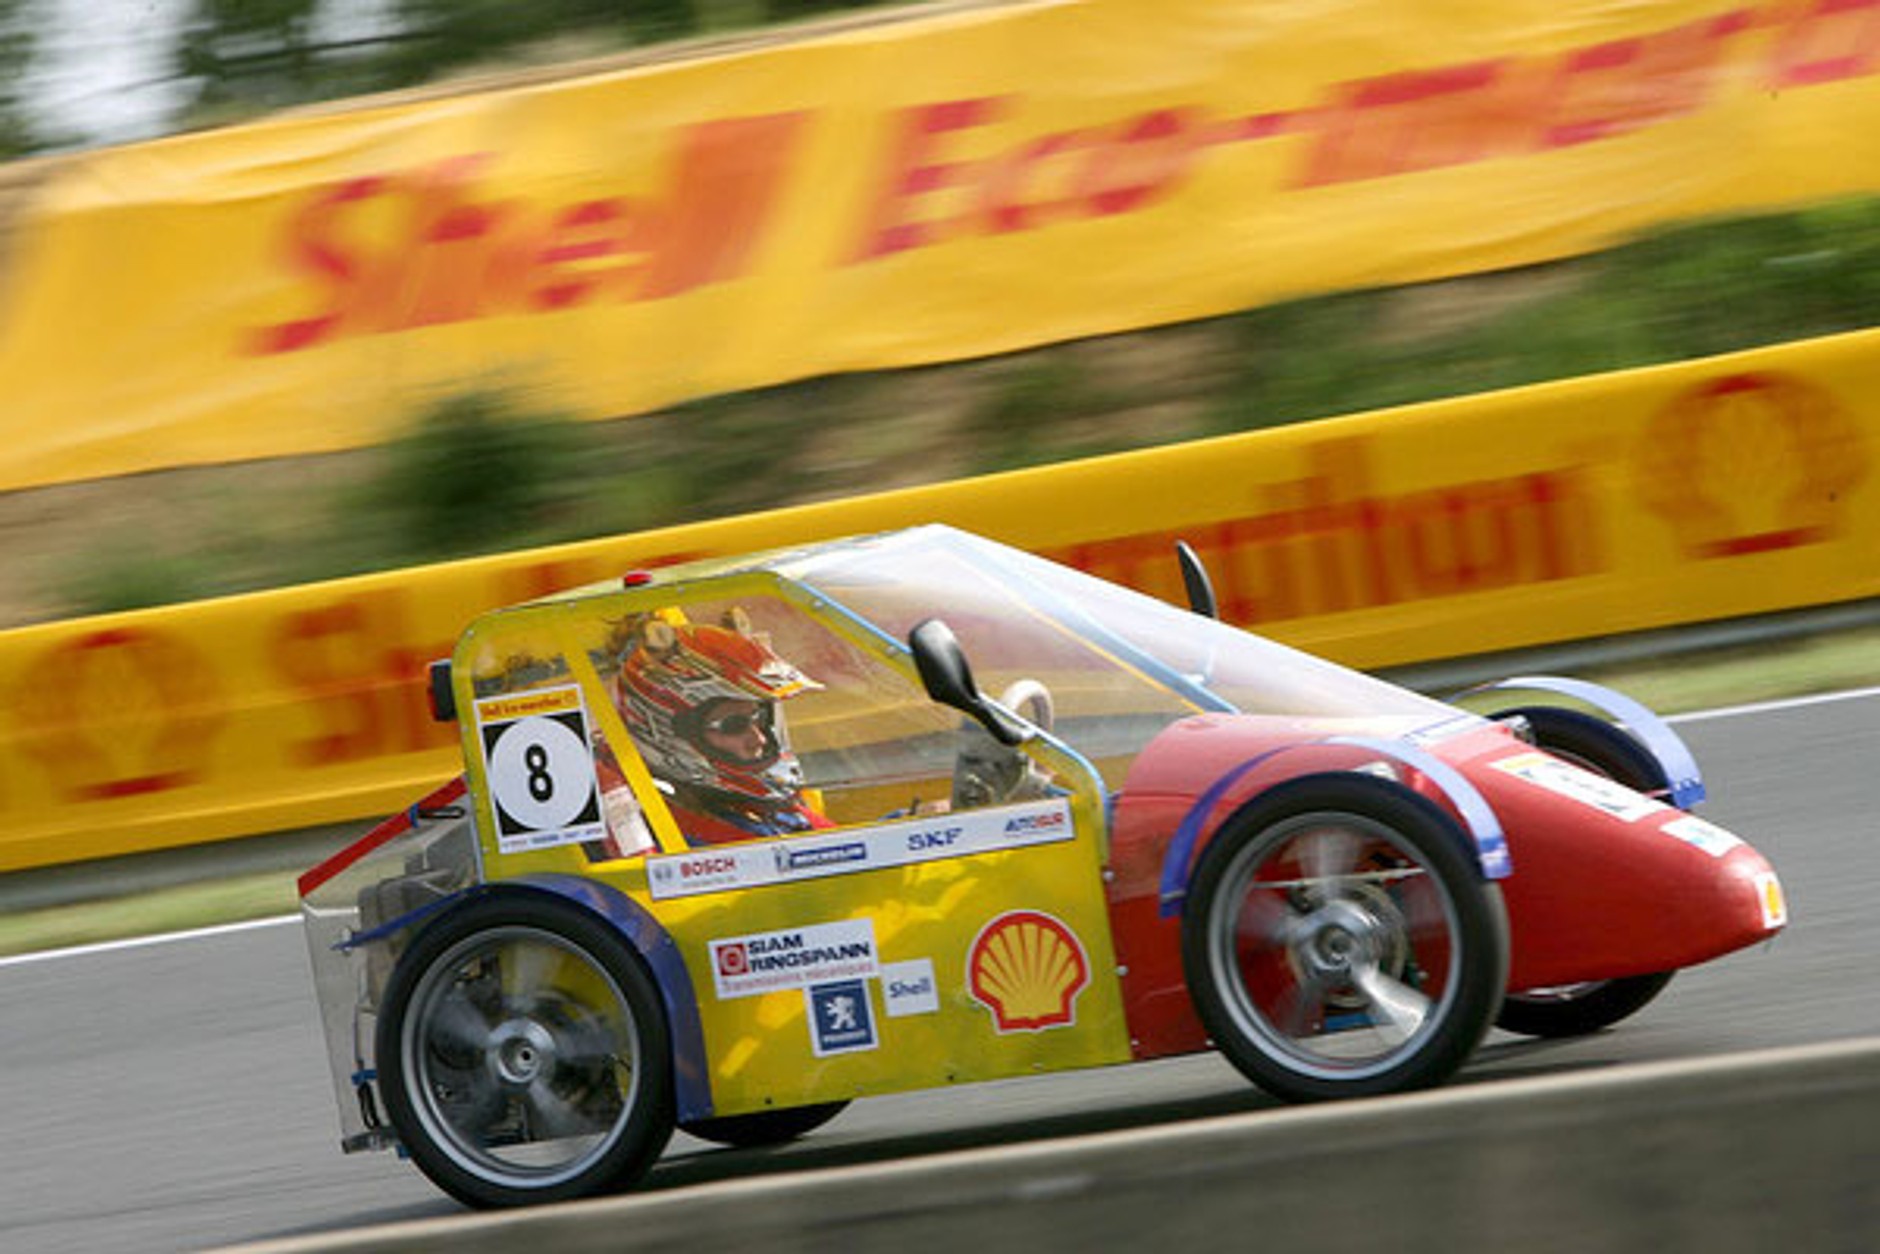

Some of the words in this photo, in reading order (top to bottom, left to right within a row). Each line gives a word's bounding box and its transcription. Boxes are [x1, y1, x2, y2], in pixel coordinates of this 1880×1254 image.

[525, 743, 553, 803] 8
[680, 857, 737, 878] BOSCH
[907, 827, 962, 851] SKF
[749, 934, 803, 955] SIAM
[749, 942, 870, 972] RINGSPANN
[889, 977, 931, 998] Shell
